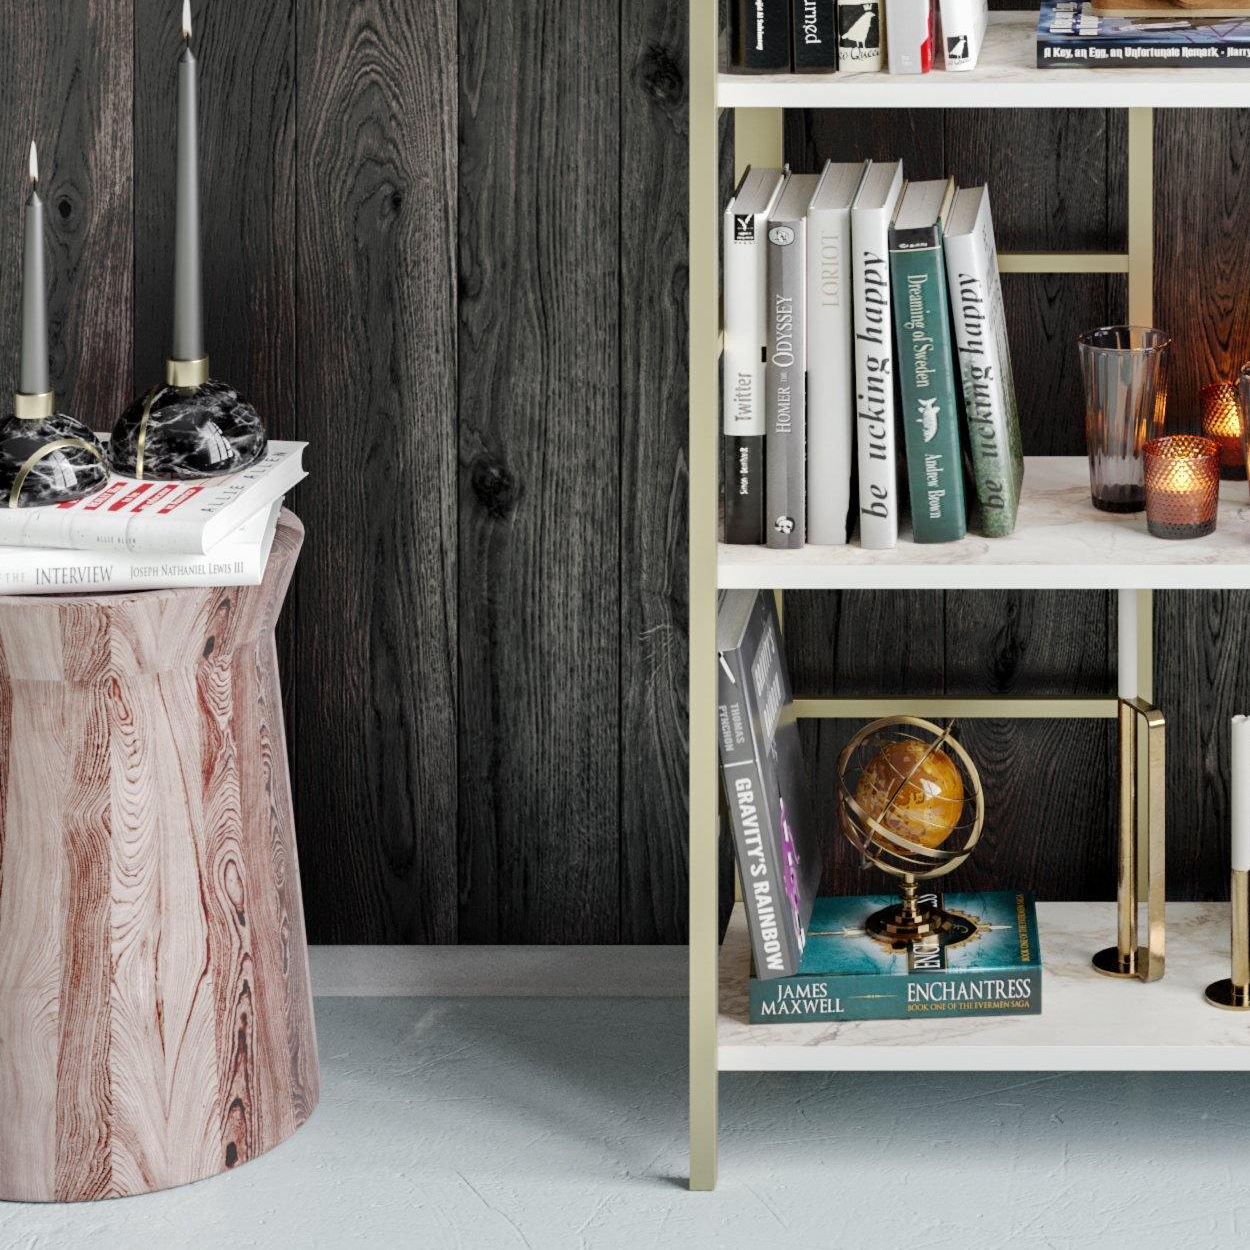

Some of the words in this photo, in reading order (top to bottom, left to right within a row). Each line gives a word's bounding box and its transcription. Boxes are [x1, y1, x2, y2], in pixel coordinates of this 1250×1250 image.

[1124, 46, 1181, 59] Unfortunate
[1181, 46, 1219, 59] Remark
[822, 230, 840, 308] LORIOT
[856, 251, 888, 346] happy
[902, 273, 928, 330] Dreaming
[958, 273, 986, 356] happy
[771, 294, 794, 368] ODYSSEY
[912, 330, 931, 342] of
[914, 343, 937, 388] Sweden
[734, 372, 752, 422] Twitter
[776, 386, 792, 433] HOMER
[857, 354, 890, 461] ucking
[965, 364, 996, 459] ucking
[924, 453, 944, 491] Andrew
[200, 484, 245, 514] ALLIE
[861, 484, 890, 519] be
[929, 492, 946, 519] Brown
[982, 479, 1005, 510] be
[6, 572, 26, 583] THE
[36, 565, 114, 586] INTERVIEW
[130, 565, 159, 580] JOSEPH
[160, 563, 207, 577] NATHANIEL
[208, 562, 232, 576] LEWIS
[730, 703, 746, 744] THOMAS
[735, 777, 768, 878] GRAVITY'S
[753, 880, 785, 972] RAINBOW
[760, 998, 844, 1017] MAXWELL
[777, 982, 828, 1002] JAMES
[907, 978, 1031, 1002] ENCHANTRESS
[907, 1004, 929, 1012] BOOK
[930, 1003, 946, 1011] ONE
[959, 1002, 973, 1010] THE
[974, 1001, 1010, 1010] EVERMEN
[1011, 1000, 1030, 1008] SAGA
